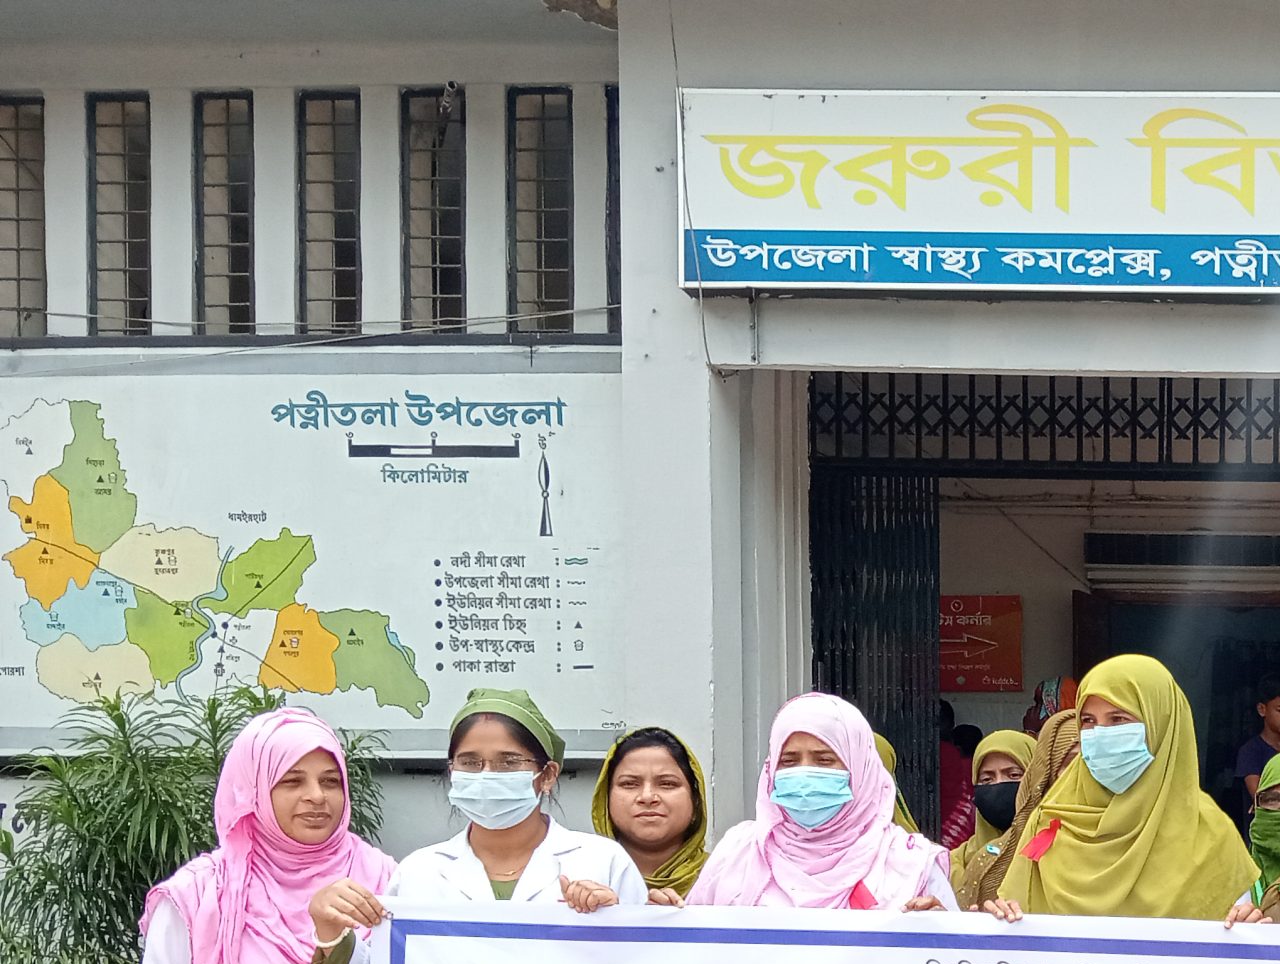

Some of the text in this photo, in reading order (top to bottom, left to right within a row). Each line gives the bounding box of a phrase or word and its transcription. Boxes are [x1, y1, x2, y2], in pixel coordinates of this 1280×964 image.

[705, 104, 1094, 212] জরুরী
[702, 236, 875, 272] উপজেলা
[886, 244, 988, 278] স্বাস্থ্য
[997, 247, 1170, 280] কমপ্লেক্স,
[271, 390, 567, 430] পত্নীতলা উপজেলা
[381, 464, 469, 483] কিলোমিটার
[450, 551, 526, 568] নদী সীমা রেখা
[444, 571, 550, 589] উপজেলা সীমা রেখা
[446, 592, 552, 612] ইউনিয়ন সীমা রেখা
[448, 614, 527, 635] ইউনিয়ন চিহ্ন
[506, 639, 535, 654] কেন্দ্র
[452, 660, 516, 674] পাকা রাস্তা
